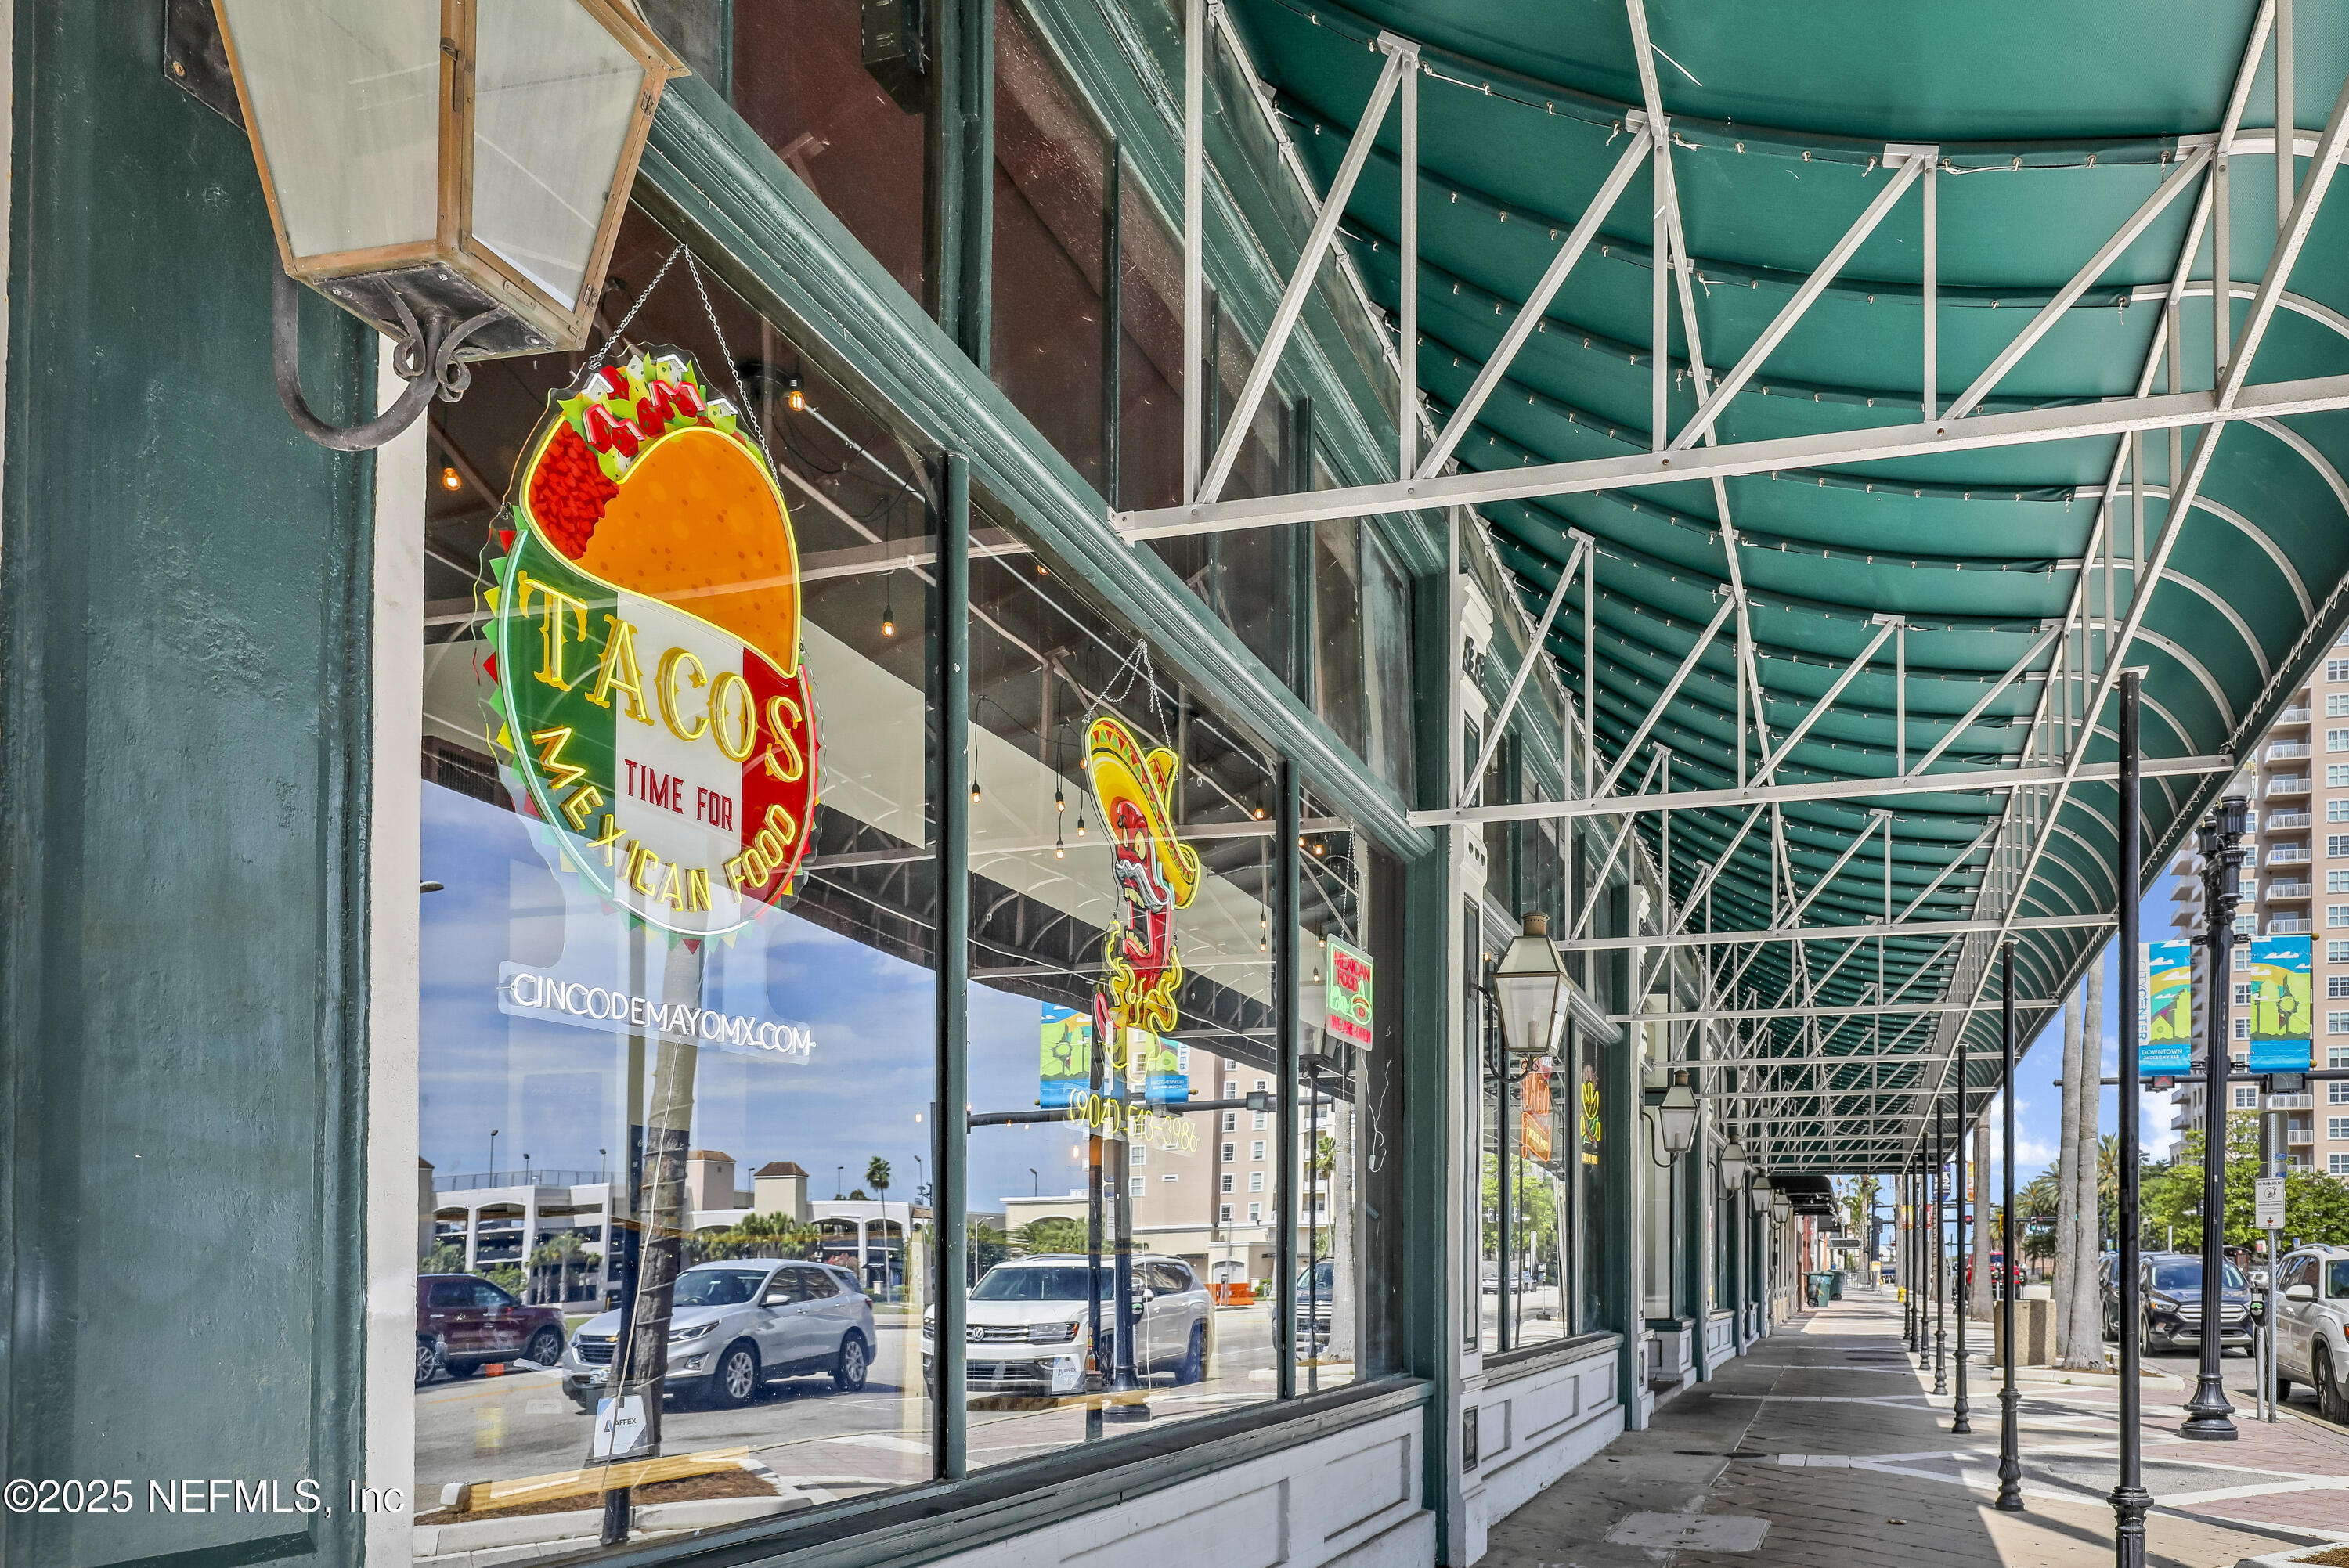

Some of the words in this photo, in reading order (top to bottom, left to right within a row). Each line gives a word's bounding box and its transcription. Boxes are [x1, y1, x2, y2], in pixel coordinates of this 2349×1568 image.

[518, 571, 803, 782] TACOS
[532, 726, 713, 913] MEXICAN
[722, 804, 796, 904] FOOD
[624, 759, 684, 814] TIME
[696, 785, 734, 832] FOR
[1334, 950, 1370, 982] MEXICAN
[1337, 969, 1359, 992] FOOD
[511, 972, 812, 1057] CINCODEMAYOMX.COM
[1331, 1014, 1342, 1032] WE
[1342, 1020, 1355, 1037] ARE
[1355, 1026, 1371, 1044] OPEN
[1069, 1087, 1120, 1134] (904)
